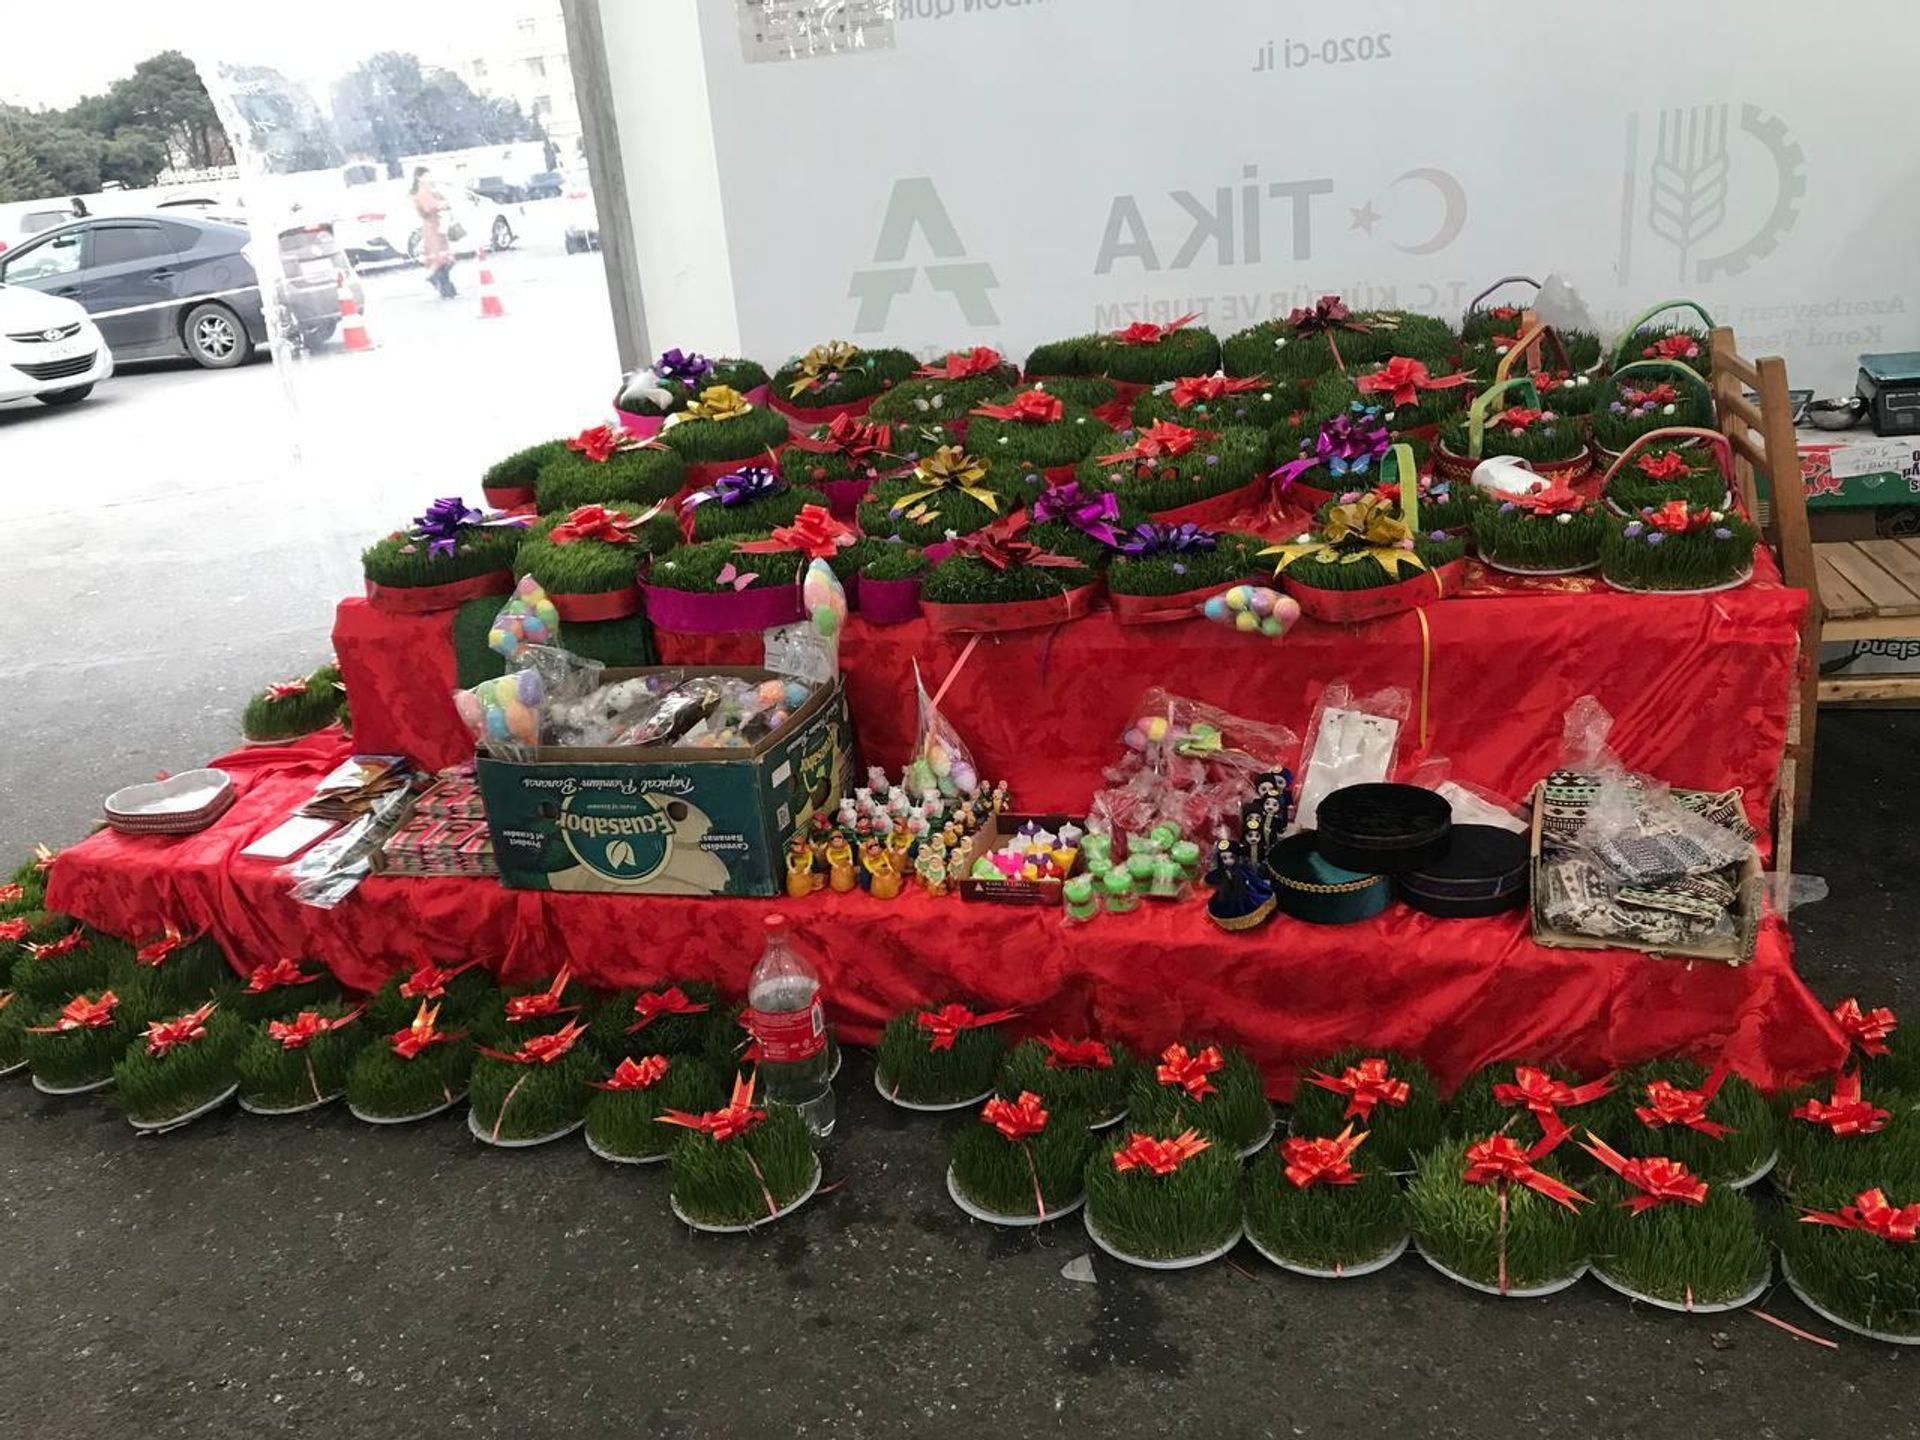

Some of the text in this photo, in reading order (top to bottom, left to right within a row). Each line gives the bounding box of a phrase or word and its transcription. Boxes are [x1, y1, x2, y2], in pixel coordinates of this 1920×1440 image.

[522, 774, 695, 795] Tropical Premium Bananas
[555, 809, 675, 837] Ecuasabor
[510, 838, 542, 849] Product
[703, 834, 744, 843] Bananas
[700, 842, 749, 851] Cavendish
